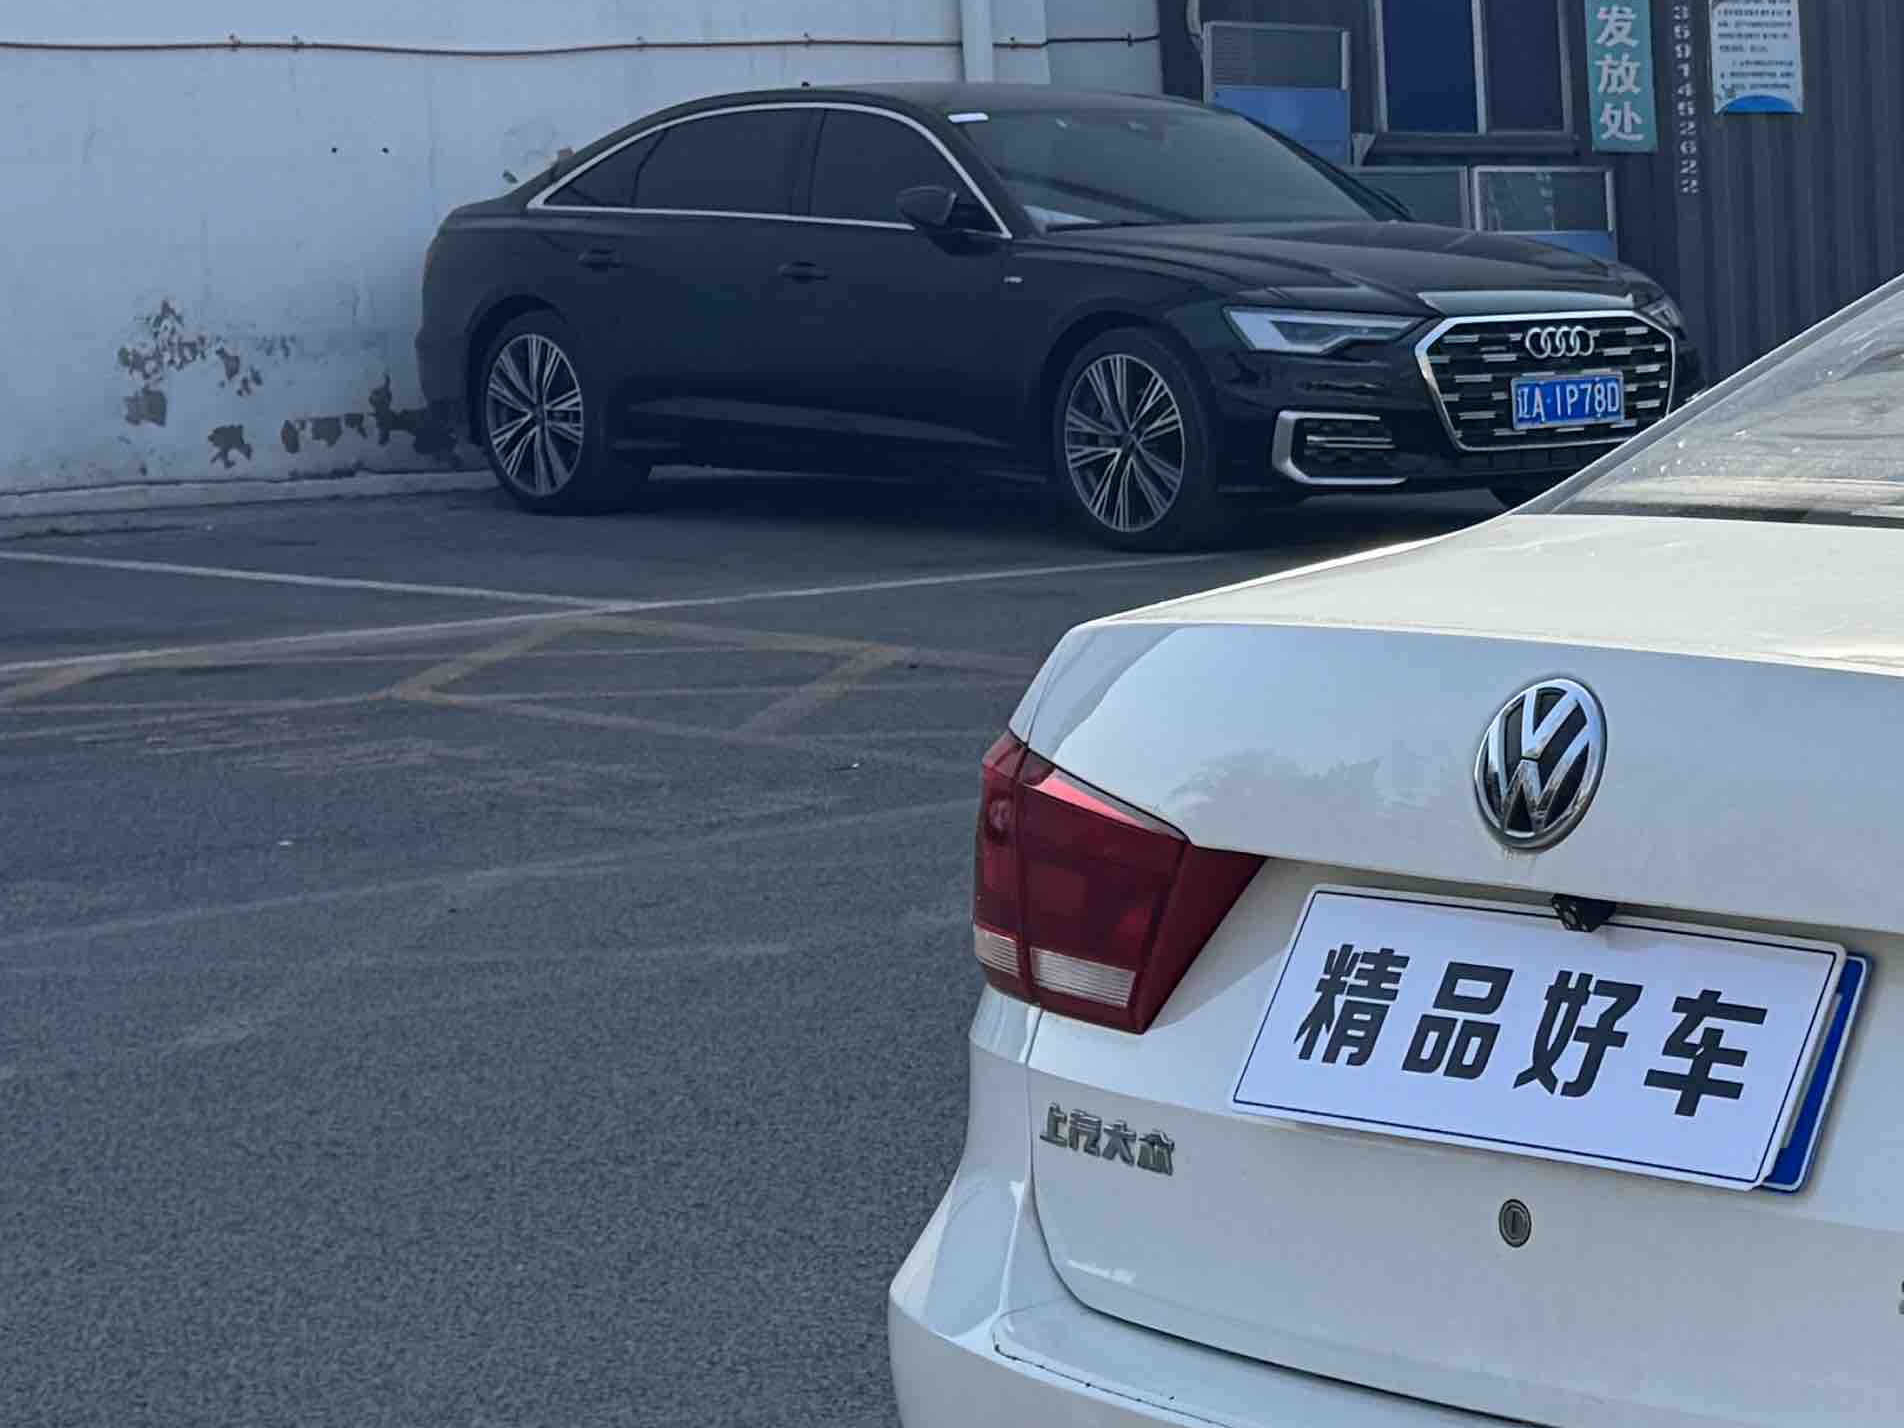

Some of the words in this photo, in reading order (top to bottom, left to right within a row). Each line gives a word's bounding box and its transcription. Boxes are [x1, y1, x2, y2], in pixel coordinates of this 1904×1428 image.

[1295, 944, 1768, 1117] 精品好车
[1039, 1100, 1175, 1177] 上汽大众
